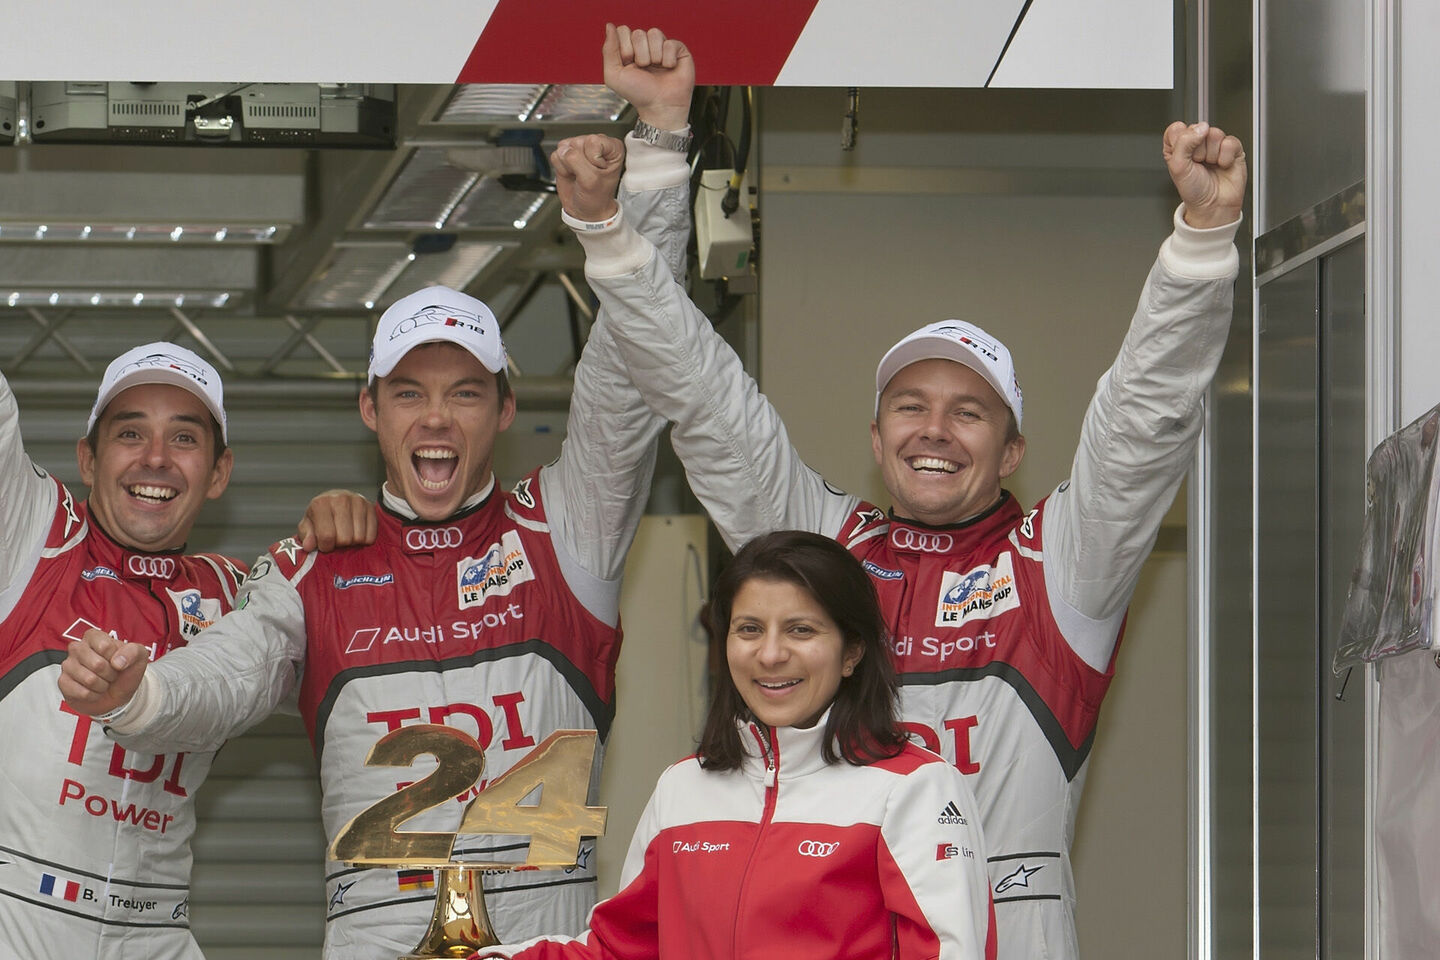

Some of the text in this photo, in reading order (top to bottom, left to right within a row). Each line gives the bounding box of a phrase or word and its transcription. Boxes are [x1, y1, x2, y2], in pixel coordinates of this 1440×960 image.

[346, 574, 392, 587] MICHELIN
[464, 593, 478, 604] LE
[943, 587, 1011, 622] LE MANS CUP
[383, 603, 523, 645] Audi Sport
[921, 631, 996, 661] Sport
[328, 723, 608, 866] 24
[59, 778, 174, 834] Power
[937, 815, 968, 826] adidas
[681, 841, 730, 853] Audi Sport
[82, 888, 98, 903] B.
